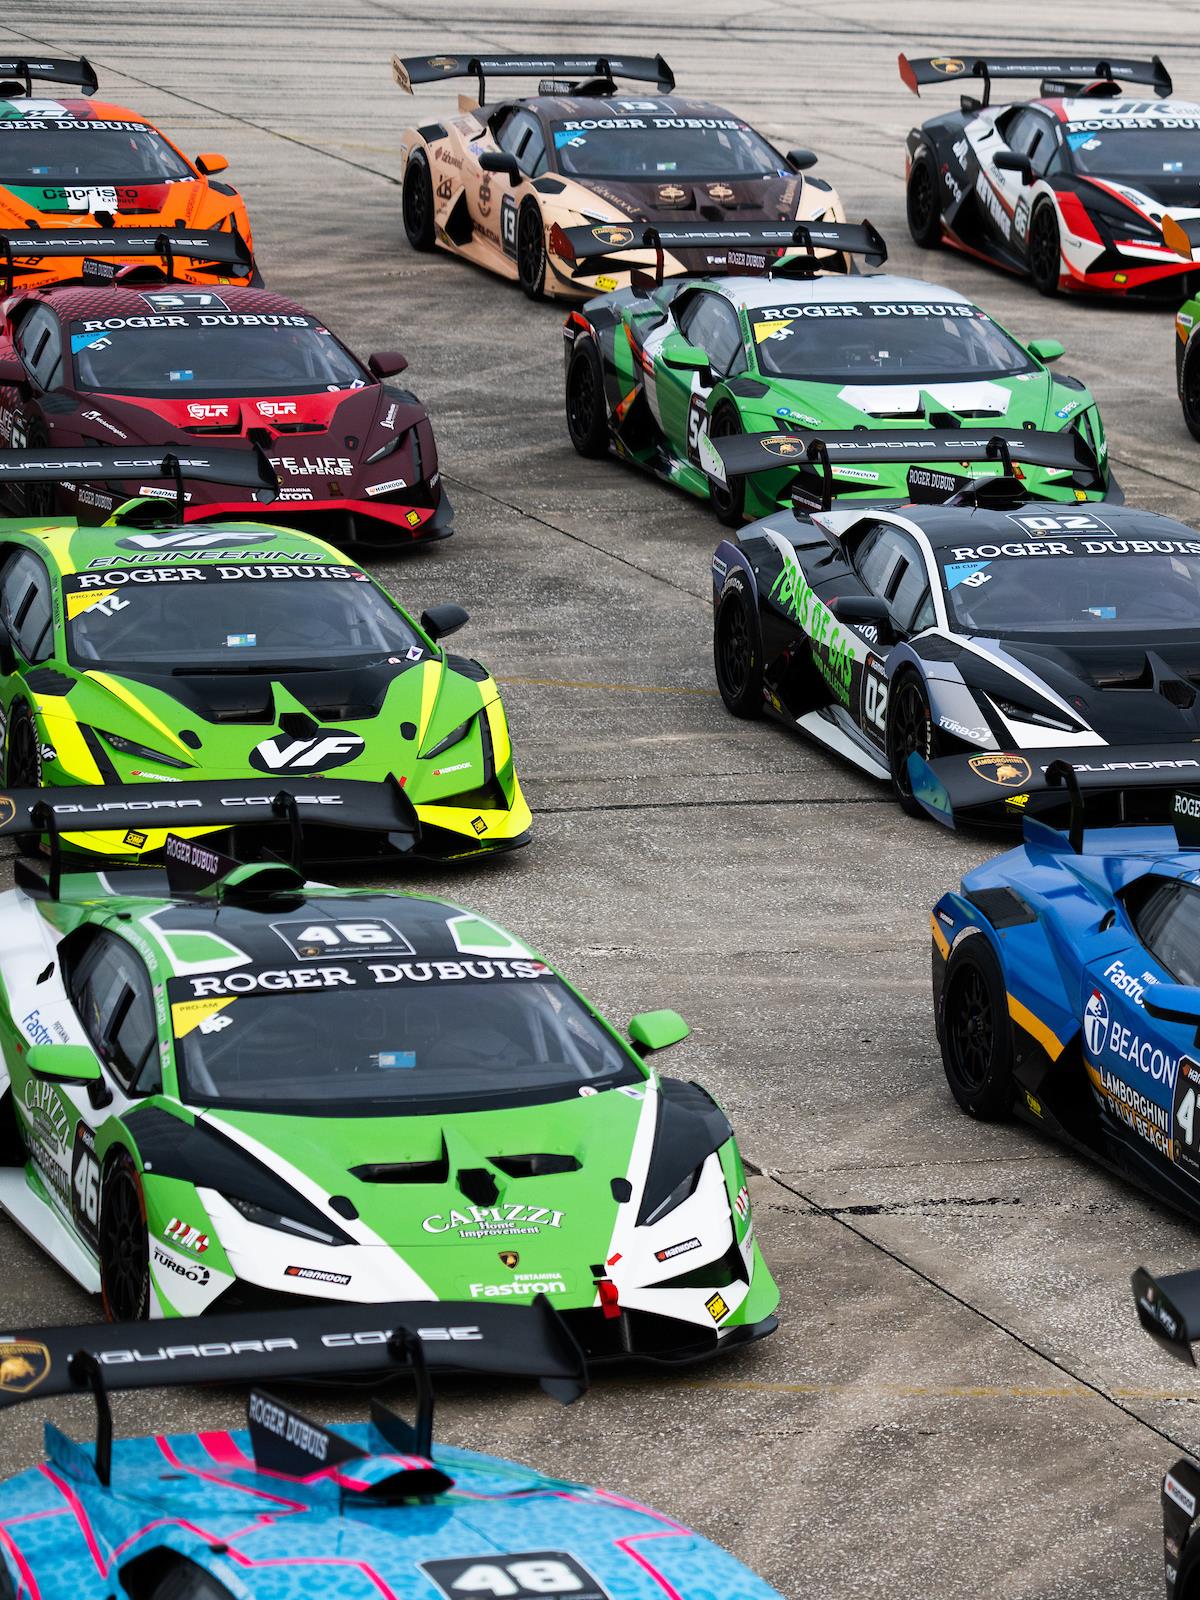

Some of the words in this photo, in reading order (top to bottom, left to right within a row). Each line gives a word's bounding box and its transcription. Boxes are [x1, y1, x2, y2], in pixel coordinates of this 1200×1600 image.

[616, 101, 659, 112] 13
[55, 120, 147, 132] DUBUIS
[563, 119, 648, 132] ROGER
[652, 119, 739, 130] DUBUIS
[1066, 119, 1156, 133] ROGER
[43, 187, 139, 203] Capristo
[503, 207, 517, 244] 13
[727, 251, 746, 266] ROGER
[745, 255, 767, 269] DUBUIS
[148, 293, 213, 306] 57
[763, 305, 863, 321] ROGER
[870, 303, 975, 318] DUBUIS
[83, 316, 190, 333] ROGER
[197, 314, 309, 328] DUBUIS
[87, 337, 113, 351] 57
[289, 466, 352, 477] DEFENSE
[305, 457, 353, 470] LIFE
[908, 469, 930, 486] ROGER
[930, 473, 956, 492] DUBUIS
[1018, 516, 1099, 530] 02
[126, 532, 268, 549] VF
[87, 550, 324, 569] ENGINEERING
[950, 541, 1075, 562] ROGER
[77, 567, 207, 589] ROGER
[215, 565, 351, 581] DUBUIS
[962, 571, 993, 588] 02
[828, 626, 856, 688] GAS
[865, 672, 889, 732] 02
[938, 717, 977, 741] TURBO
[256, 736, 365, 769] VF
[972, 755, 1025, 767] LAMBORGHINI
[126, 834, 144, 845] OMP
[167, 837, 191, 866] ROGER
[191, 846, 219, 874] DUBUIS
[296, 924, 393, 946] 46
[190, 966, 357, 997] ROGER
[368, 960, 535, 984] DUBUIS
[179, 1002, 218, 1012] PRO-AM
[1109, 1021, 1177, 1089] BEACON
[1100, 1066, 1169, 1133] LAMBORGHINI
[1107, 1094, 1135, 1134] PALM
[1137, 1118, 1169, 1160] BEACH
[74, 1151, 101, 1226] 46
[422, 1203, 566, 1234] CAPIZZI
[479, 1221, 515, 1230] Home
[459, 1226, 539, 1239] Improvement
[154, 1251, 199, 1284] TURBO
[514, 1273, 562, 1281] PERTAMINA
[469, 1281, 567, 1298] Fastron
[708, 1298, 726, 1317] OMP
[248, 1394, 285, 1434] ROGER
[285, 1415, 329, 1461] DUBUIS
[450, 1559, 585, 1596] 48
